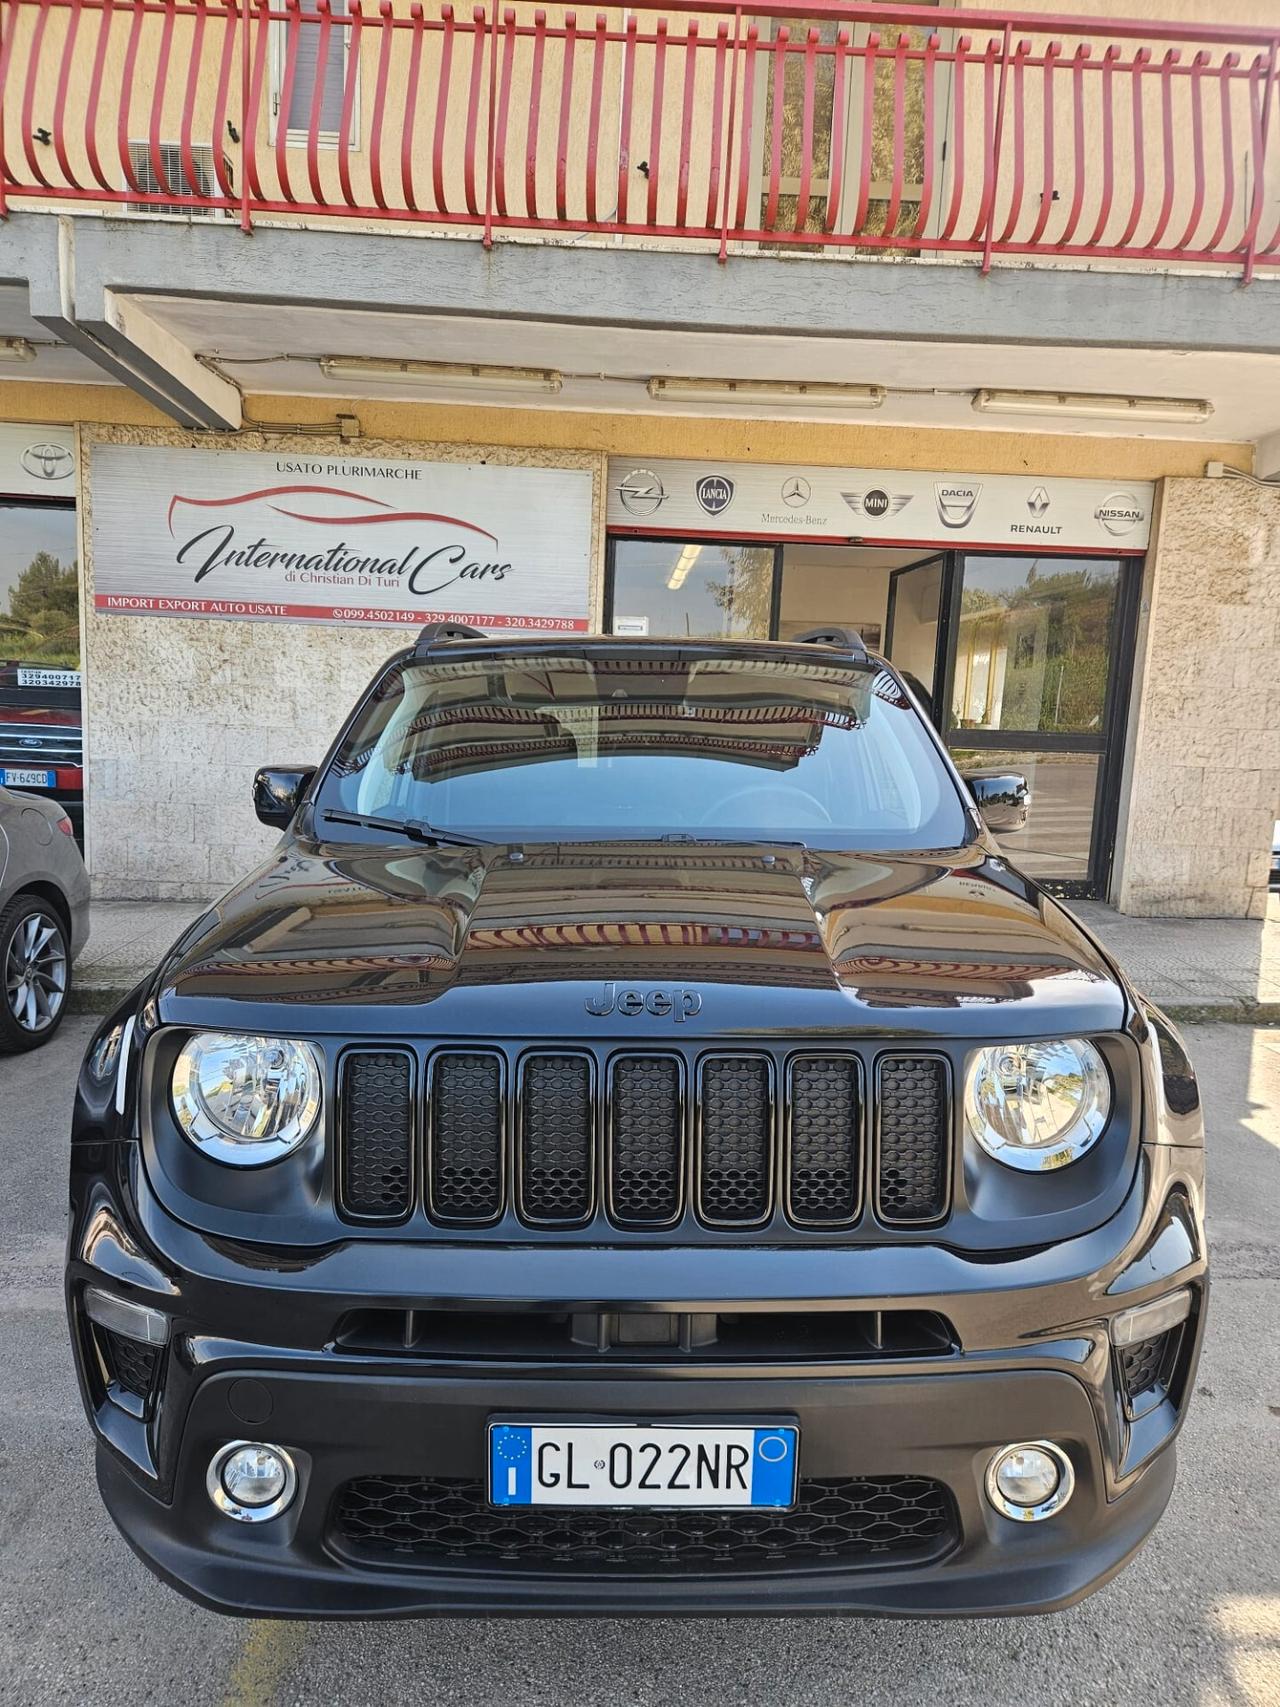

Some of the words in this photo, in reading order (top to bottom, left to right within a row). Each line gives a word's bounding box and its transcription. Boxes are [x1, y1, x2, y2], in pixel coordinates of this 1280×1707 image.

[276, 461, 323, 475] USATO
[327, 464, 423, 480] PLURIMARCHE
[702, 487, 727, 500] LANCIA
[941, 488, 974, 498] DACIA
[864, 497, 889, 508] MINI
[761, 513, 828, 526] Mercedes-Benz
[1099, 509, 1140, 518] NISSAN
[1010, 524, 1063, 535] RENAULT
[176, 524, 419, 584] International
[408, 544, 513, 595] Cars
[284, 572, 296, 583] di
[300, 572, 354, 586] Christian
[358, 574, 373, 587] Di
[376, 575, 400, 588] Turi
[107, 596, 155, 609] IMPORT
[158, 599, 207, 611] EXPORT
[209, 601, 246, 613] AUTO
[249, 604, 288, 616] USATE
[343, 609, 415, 622] 099.4502149
[425, 613, 495, 626] 329.4007177
[505, 617, 575, 630] 320.3429788
[584, 982, 702, 1022] Jeep
